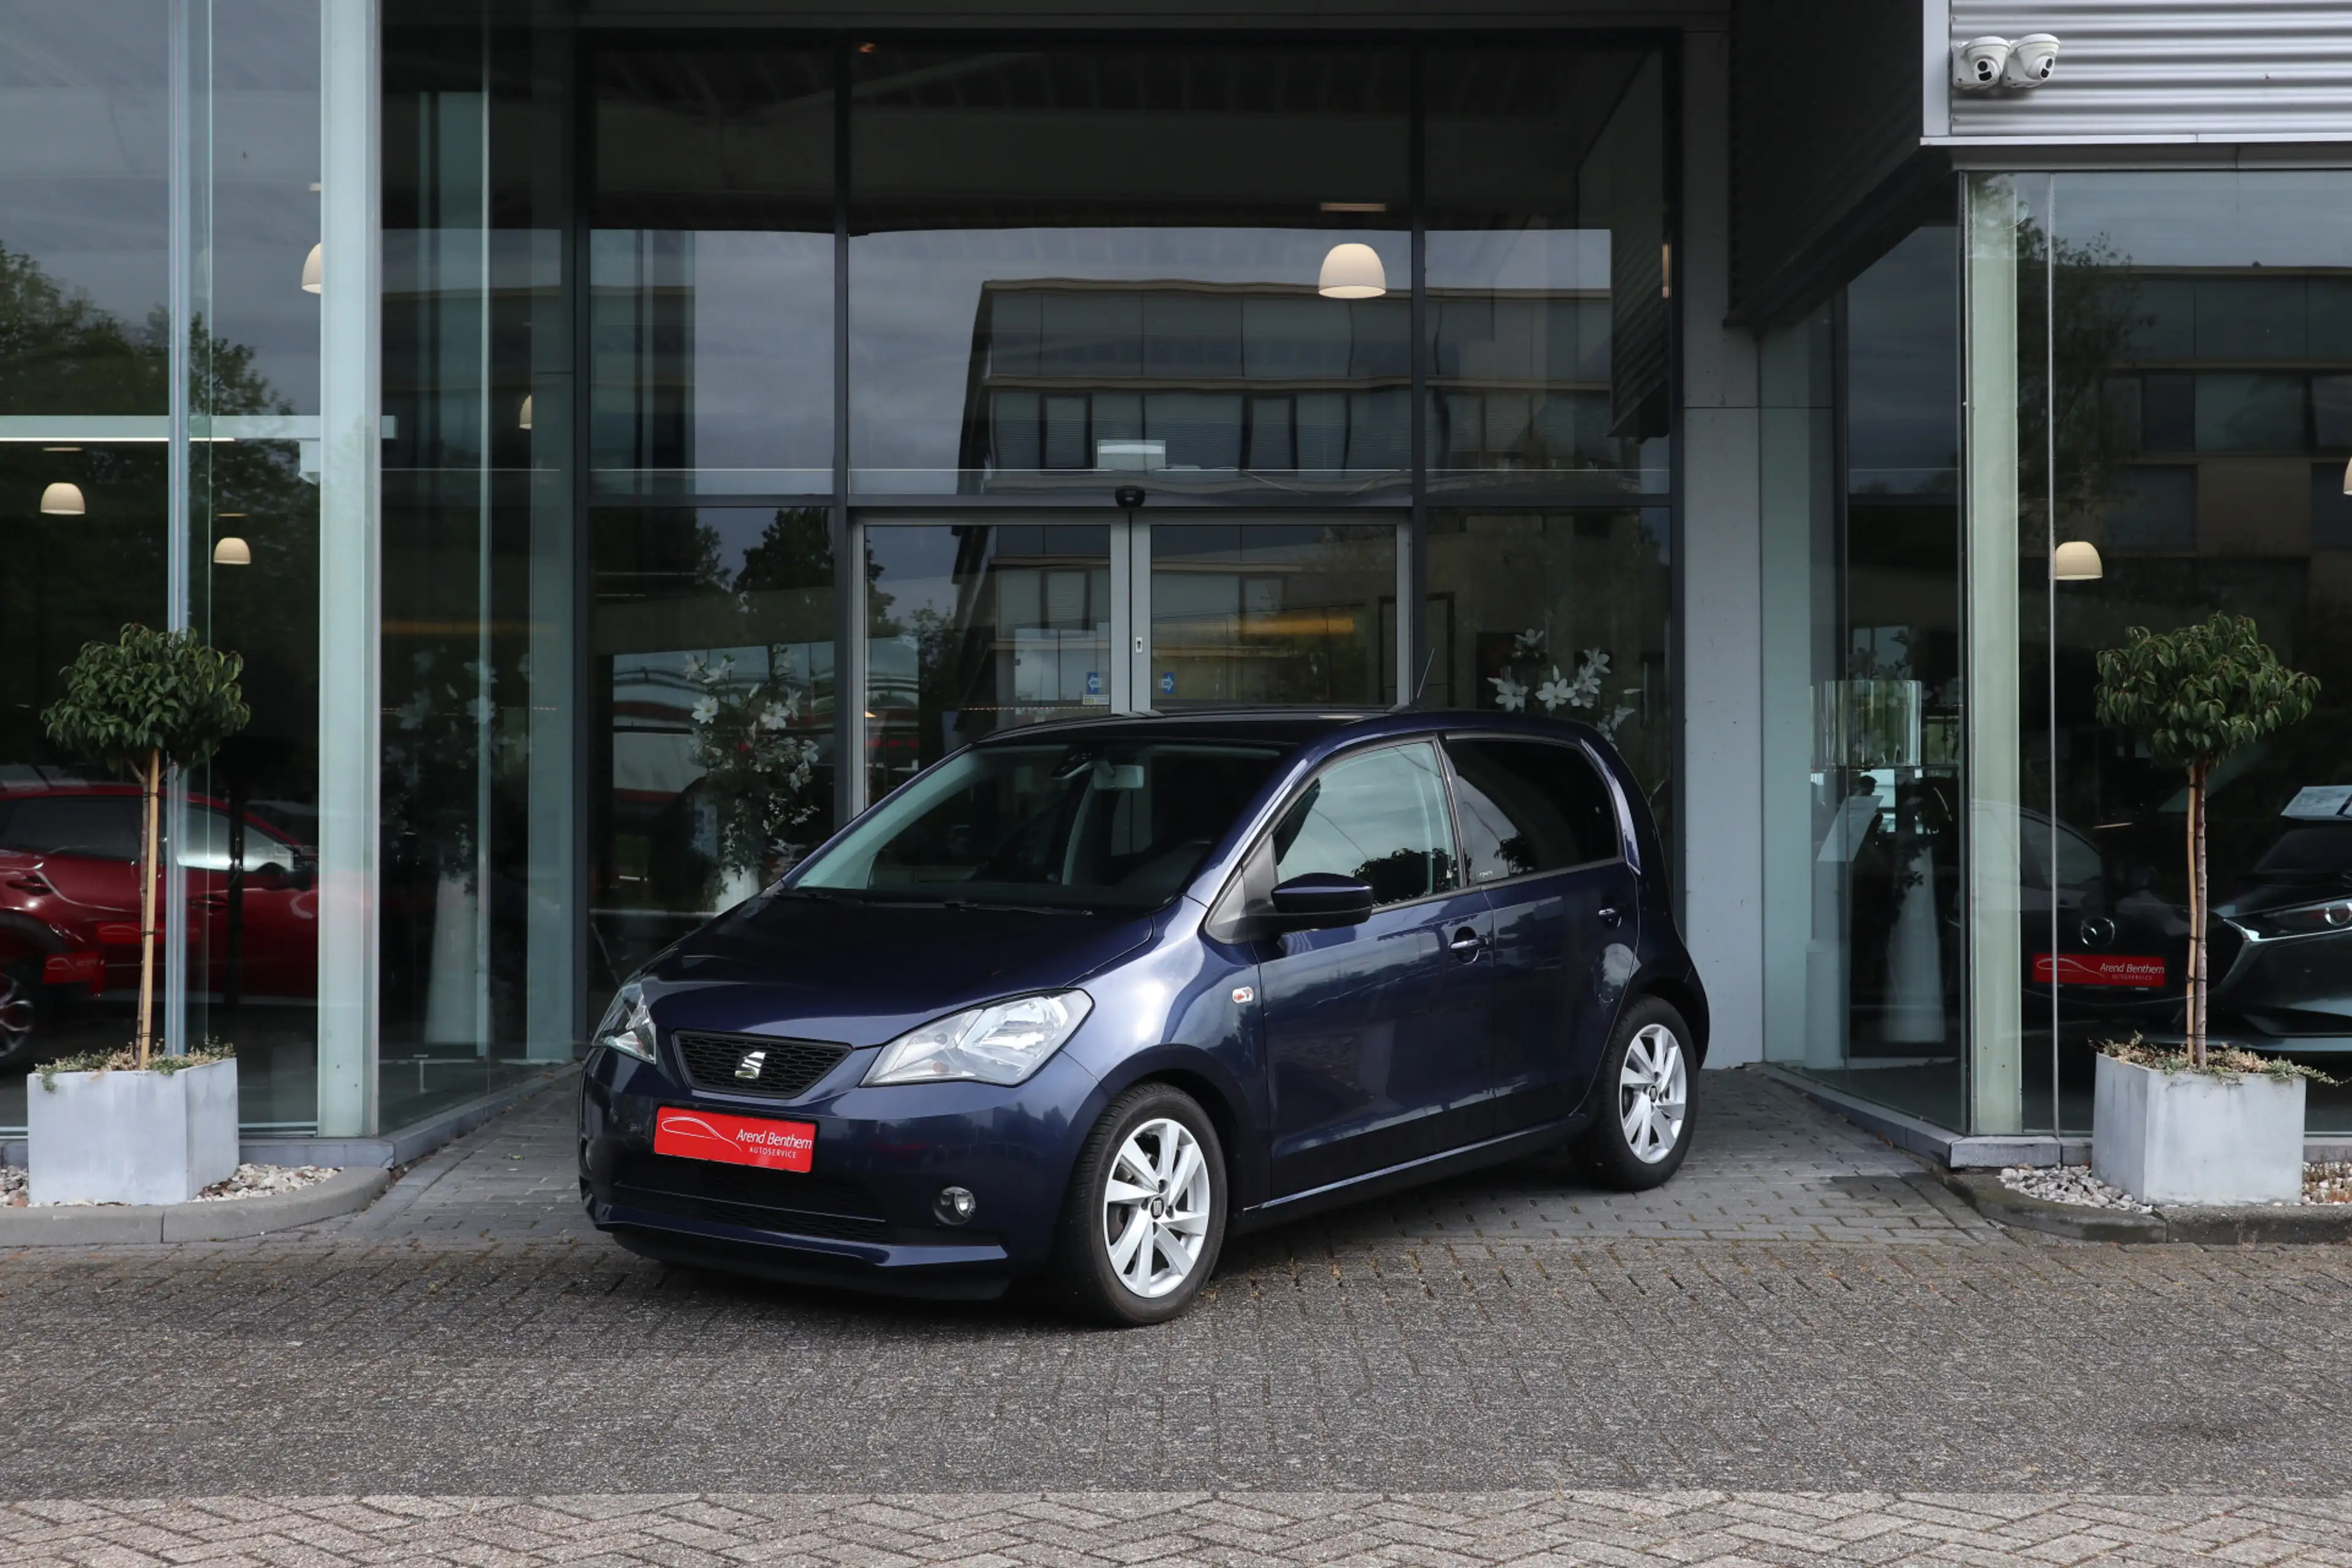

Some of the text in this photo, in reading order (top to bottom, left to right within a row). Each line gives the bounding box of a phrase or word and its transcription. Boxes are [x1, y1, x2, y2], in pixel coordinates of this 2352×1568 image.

[2100, 962, 2165, 974] Arend Benthem
[736, 1128, 812, 1150] Arend Benthem
[749, 1146, 797, 1159] AUTOSERVICE
